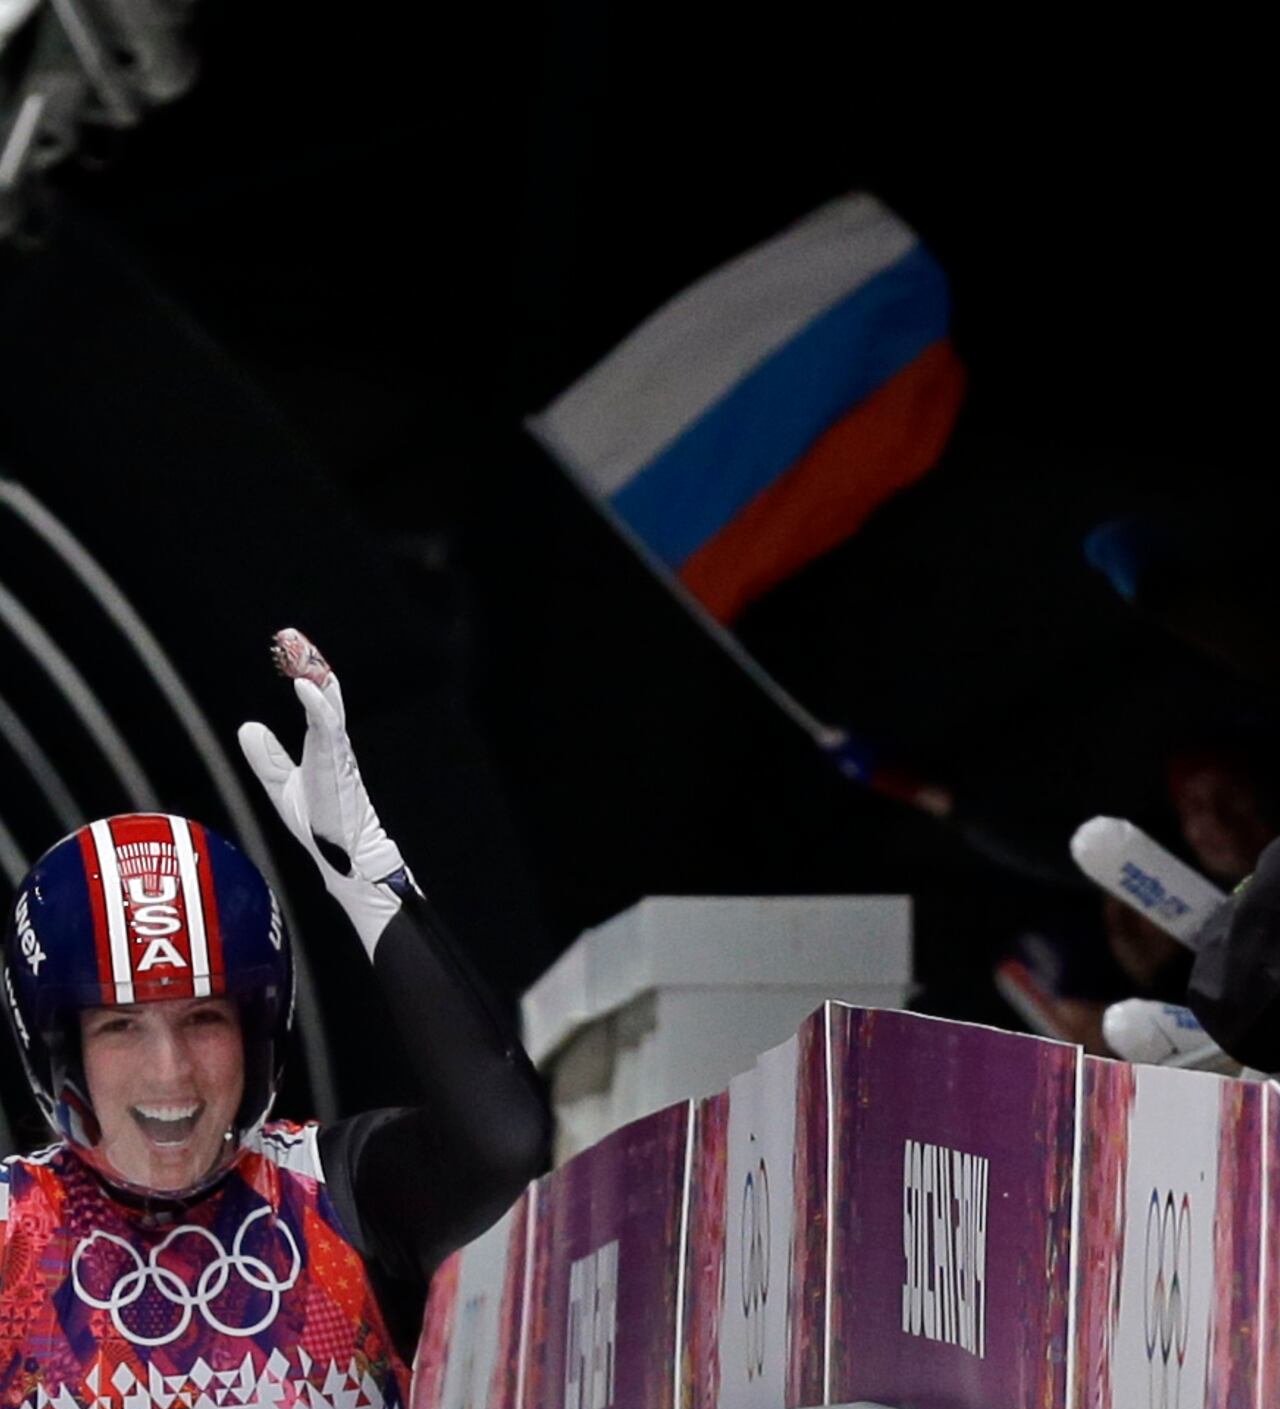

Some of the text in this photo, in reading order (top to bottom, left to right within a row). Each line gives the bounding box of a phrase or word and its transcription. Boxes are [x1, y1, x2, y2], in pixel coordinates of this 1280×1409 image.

[15, 890, 47, 976] uvex
[128, 874, 188, 972] USA
[902, 1138, 989, 1359] SOCHI 2014
